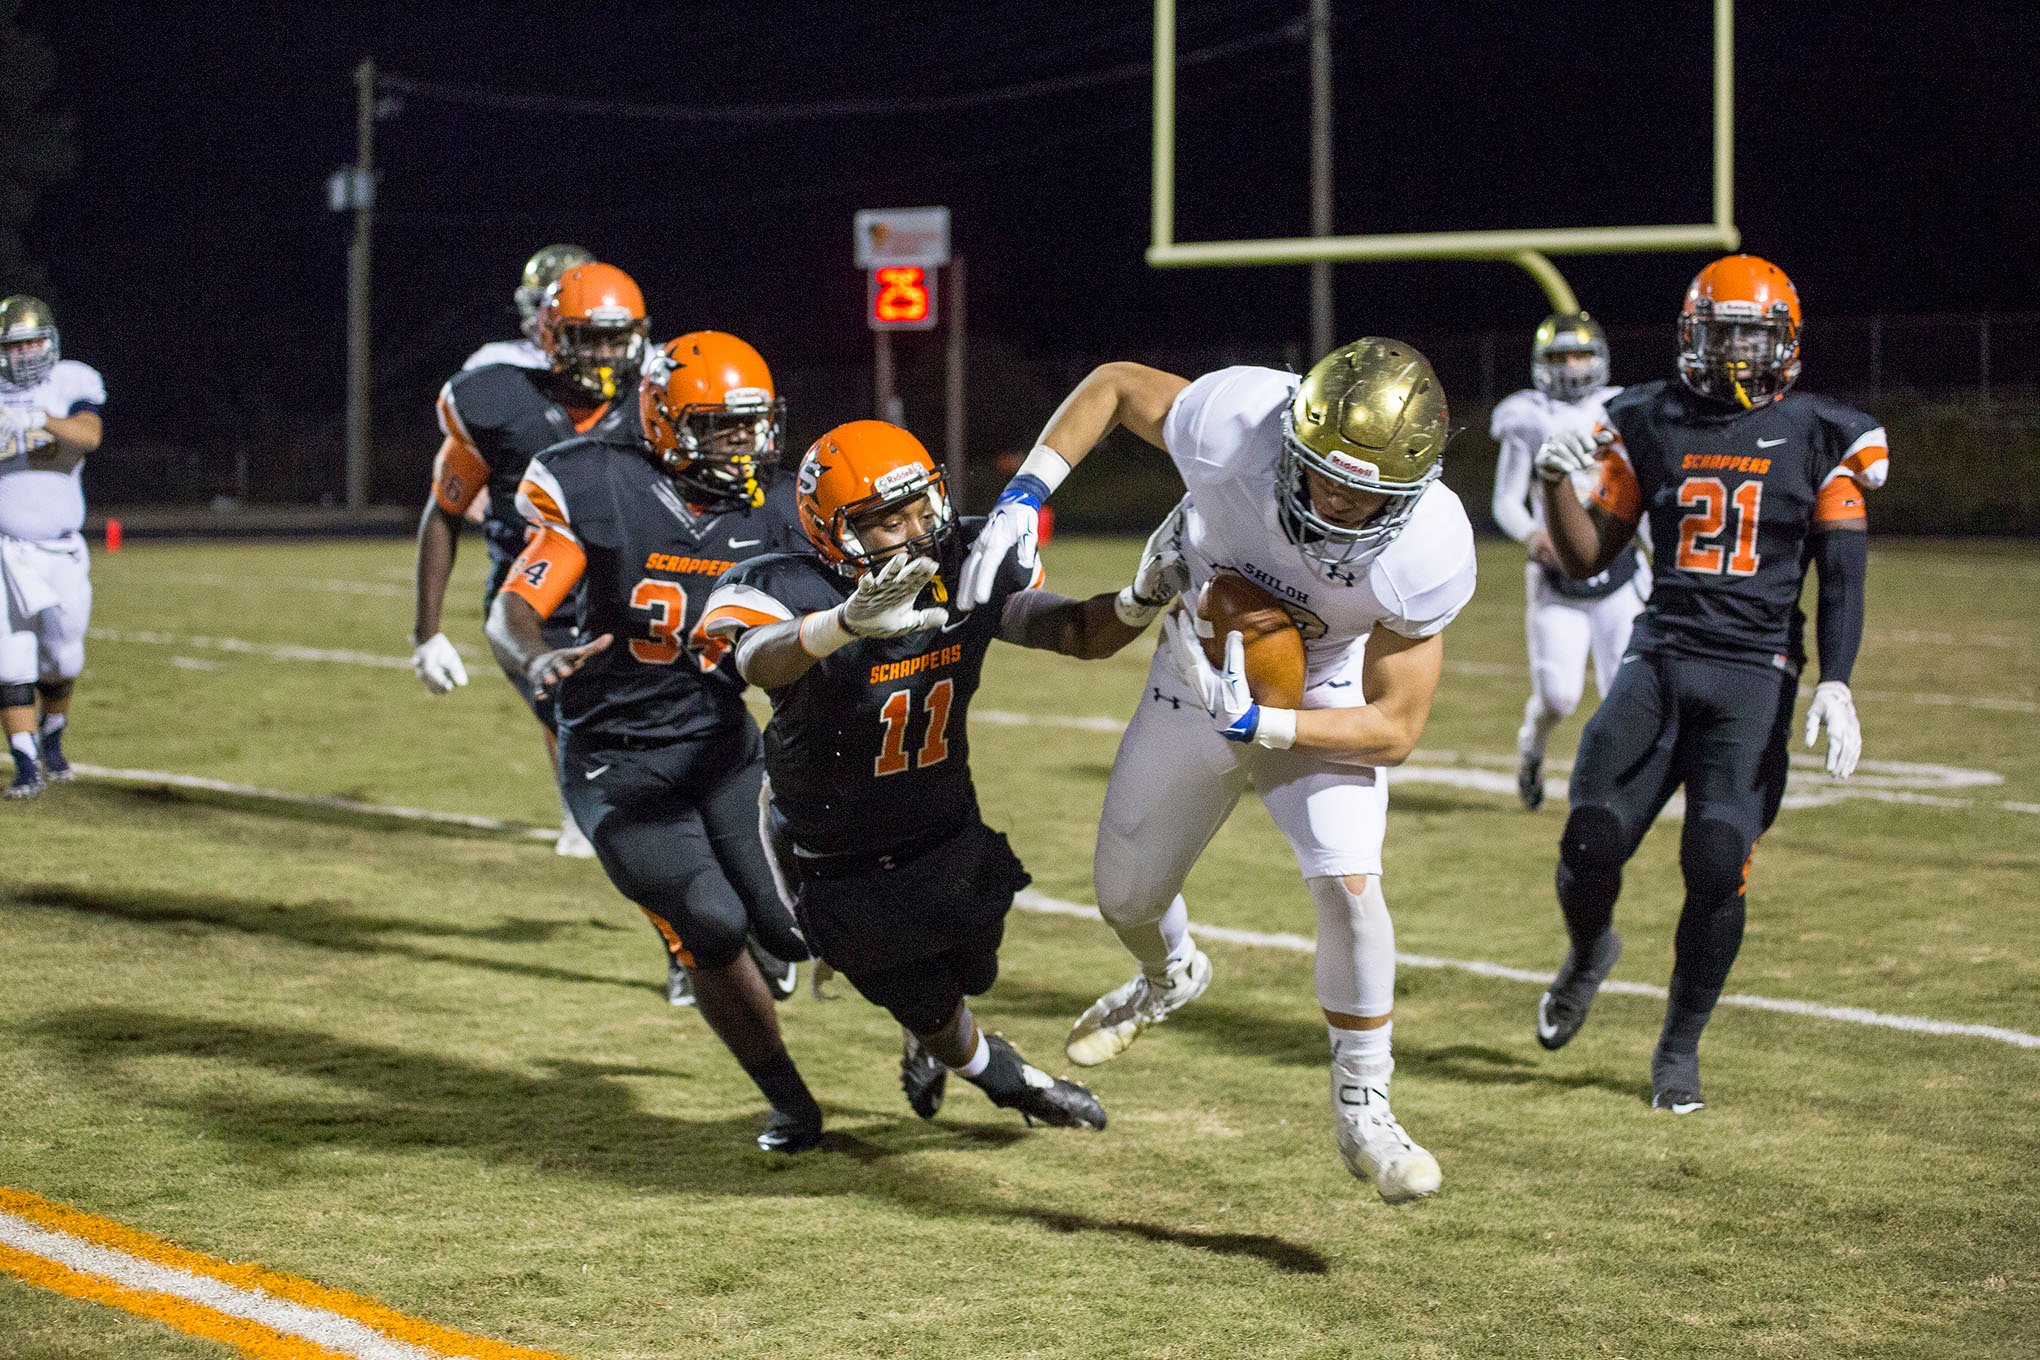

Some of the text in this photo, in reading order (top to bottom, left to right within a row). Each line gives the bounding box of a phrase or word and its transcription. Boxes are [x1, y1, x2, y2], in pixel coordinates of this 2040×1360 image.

[886, 468, 914, 484] Riddell
[1332, 455, 1374, 477] Riddell
[1682, 453, 1772, 475] SCRAPPERS
[1675, 477, 1764, 577] 21
[645, 552, 738, 577] SCRAPPER
[1243, 562, 1310, 604] SHILOH
[869, 643, 962, 685] SCRAPPERS
[874, 677, 955, 778] 11
